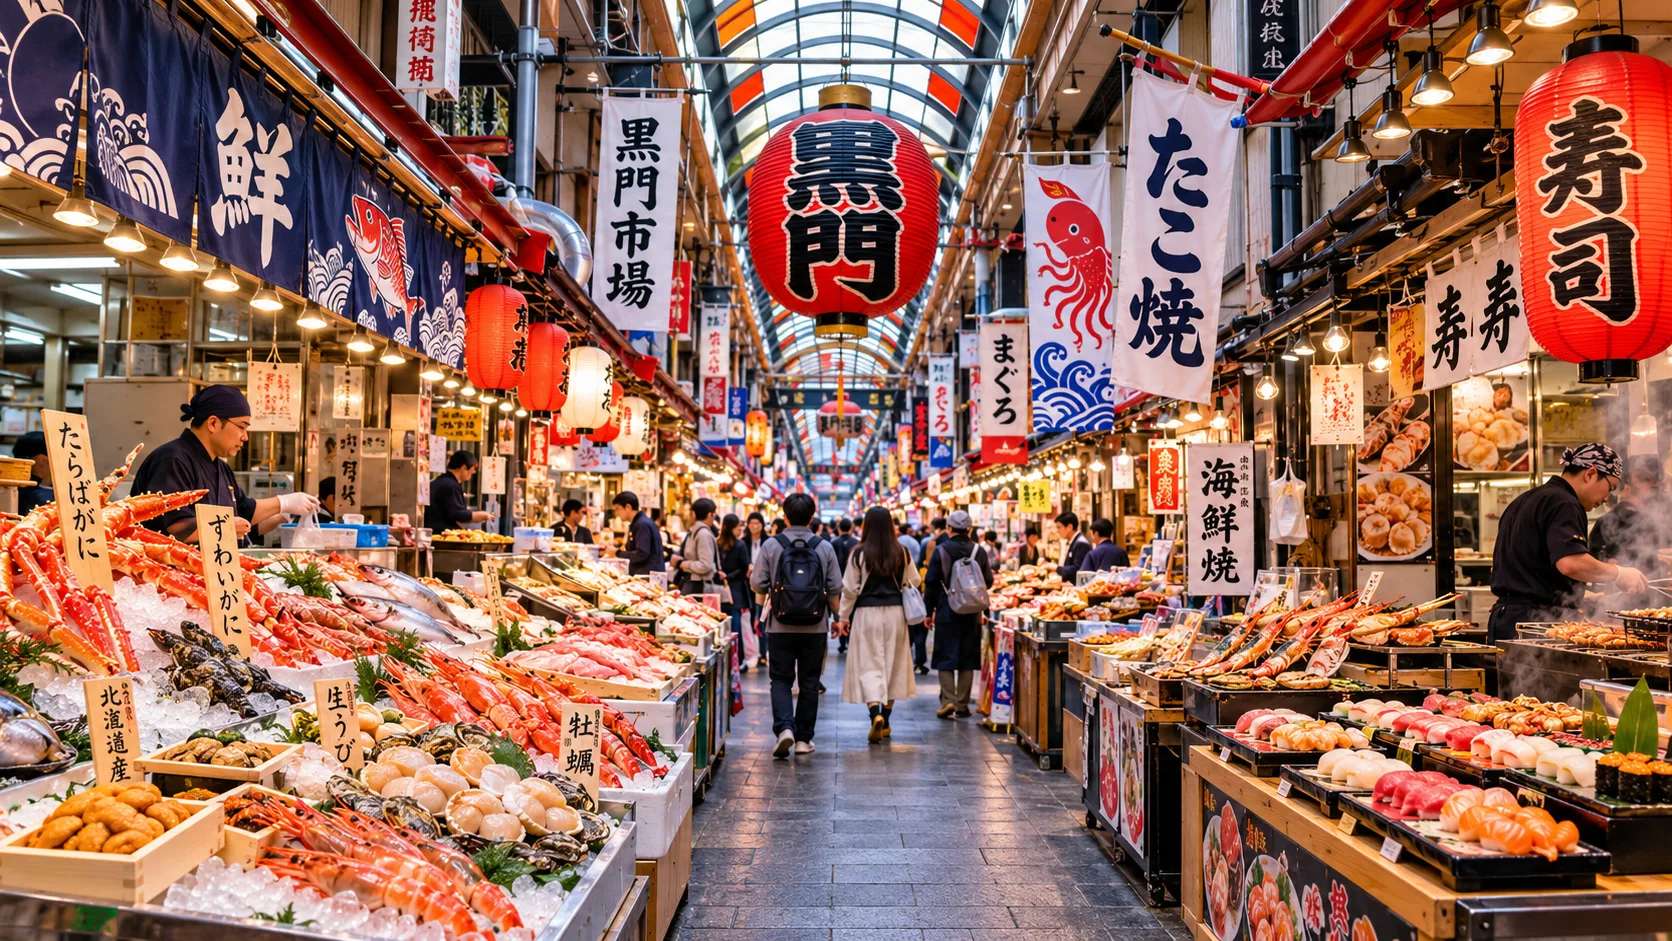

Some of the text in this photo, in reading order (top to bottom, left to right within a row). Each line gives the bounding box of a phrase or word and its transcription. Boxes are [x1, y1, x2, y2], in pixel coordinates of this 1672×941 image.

[211, 87, 294, 269] 鮮
[606, 117, 661, 310] 黒門市場
[782, 119, 907, 304] 黒門
[1128, 117, 1209, 368] たこ焼
[1536, 96, 1646, 325] 寿司
[992, 333, 1018, 425] まぐろ
[1432, 284, 1467, 372] 寿
[1479, 259, 1520, 354] 寿
[59, 421, 99, 560] たらばがに
[1201, 457, 1240, 583] 海鮮焼
[208, 513, 242, 635] ずわいがに
[565, 711, 594, 776] 牡蠣
